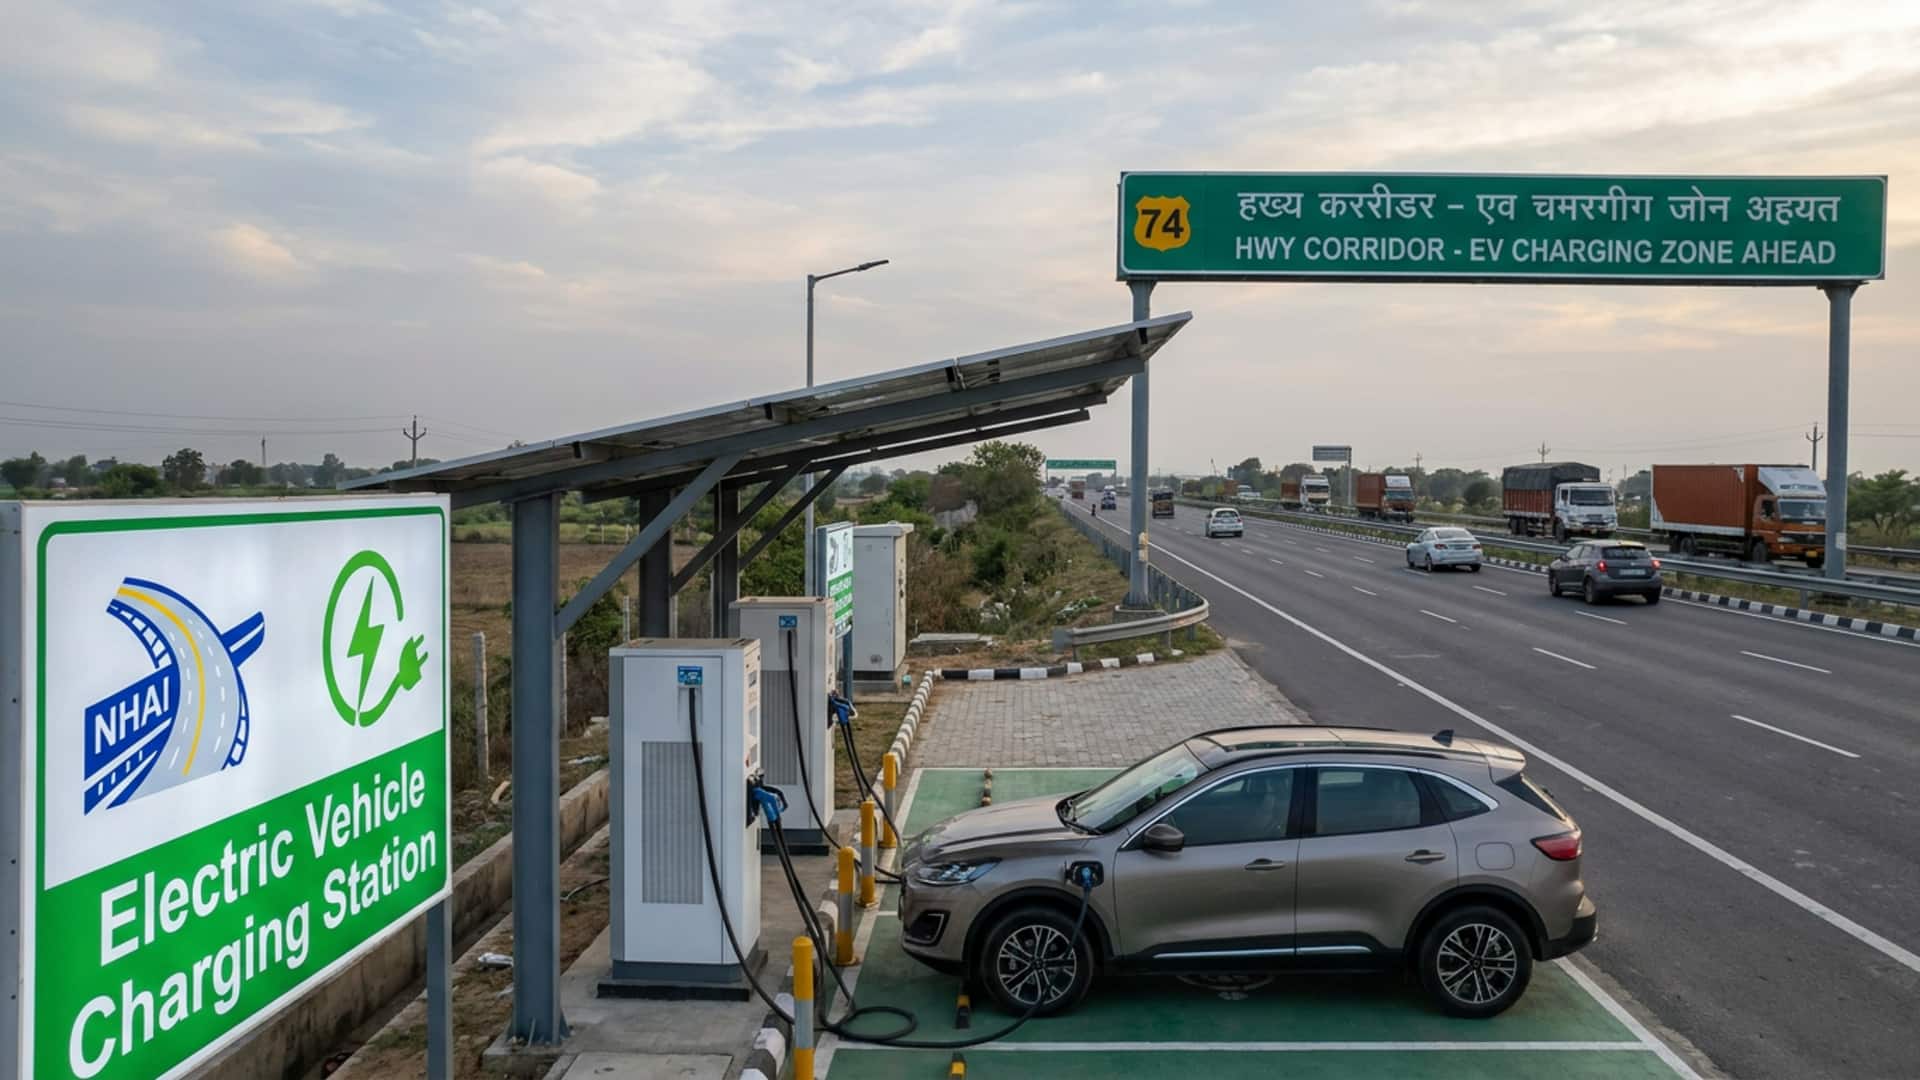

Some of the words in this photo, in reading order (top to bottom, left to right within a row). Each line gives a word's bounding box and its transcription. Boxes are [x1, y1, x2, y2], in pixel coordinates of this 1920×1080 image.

[1140, 208, 1185, 239] 74
[1667, 185, 1731, 222] जोन
[1235, 236, 1296, 260] HWY
[1303, 236, 1445, 261] CORRIDOR
[1470, 238, 1504, 261] EV
[1511, 238, 1652, 263] CHARGING
[1660, 239, 1733, 264] ZONE
[1741, 240, 1836, 264] AHEAD
[95, 676, 169, 754] NHAI
[101, 823, 294, 967] Electric
[305, 762, 425, 858] Vehicle
[69, 899, 310, 1079] Charging
[323, 830, 436, 929] Station
